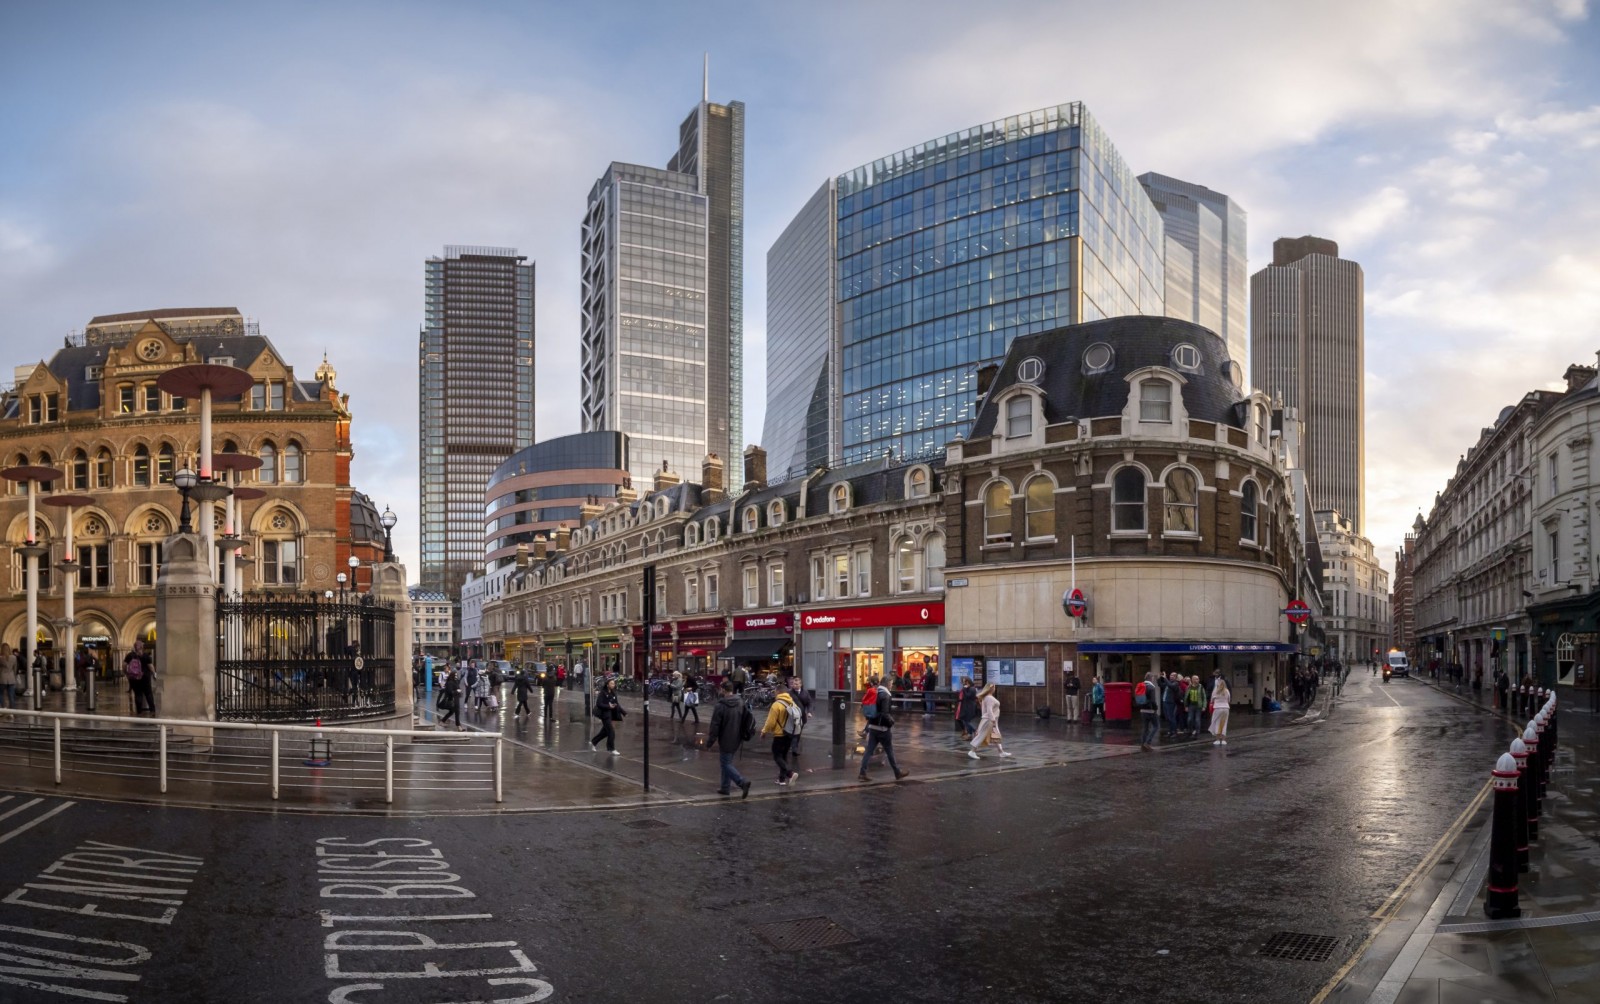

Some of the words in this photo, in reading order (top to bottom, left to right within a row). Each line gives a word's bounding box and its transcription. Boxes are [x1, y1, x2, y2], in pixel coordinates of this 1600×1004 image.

[745, 618, 764, 627] COSTA
[812, 616, 836, 624] vodafone
[1, 840, 204, 925] ENTRY
[316, 837, 476, 899] BUSES
